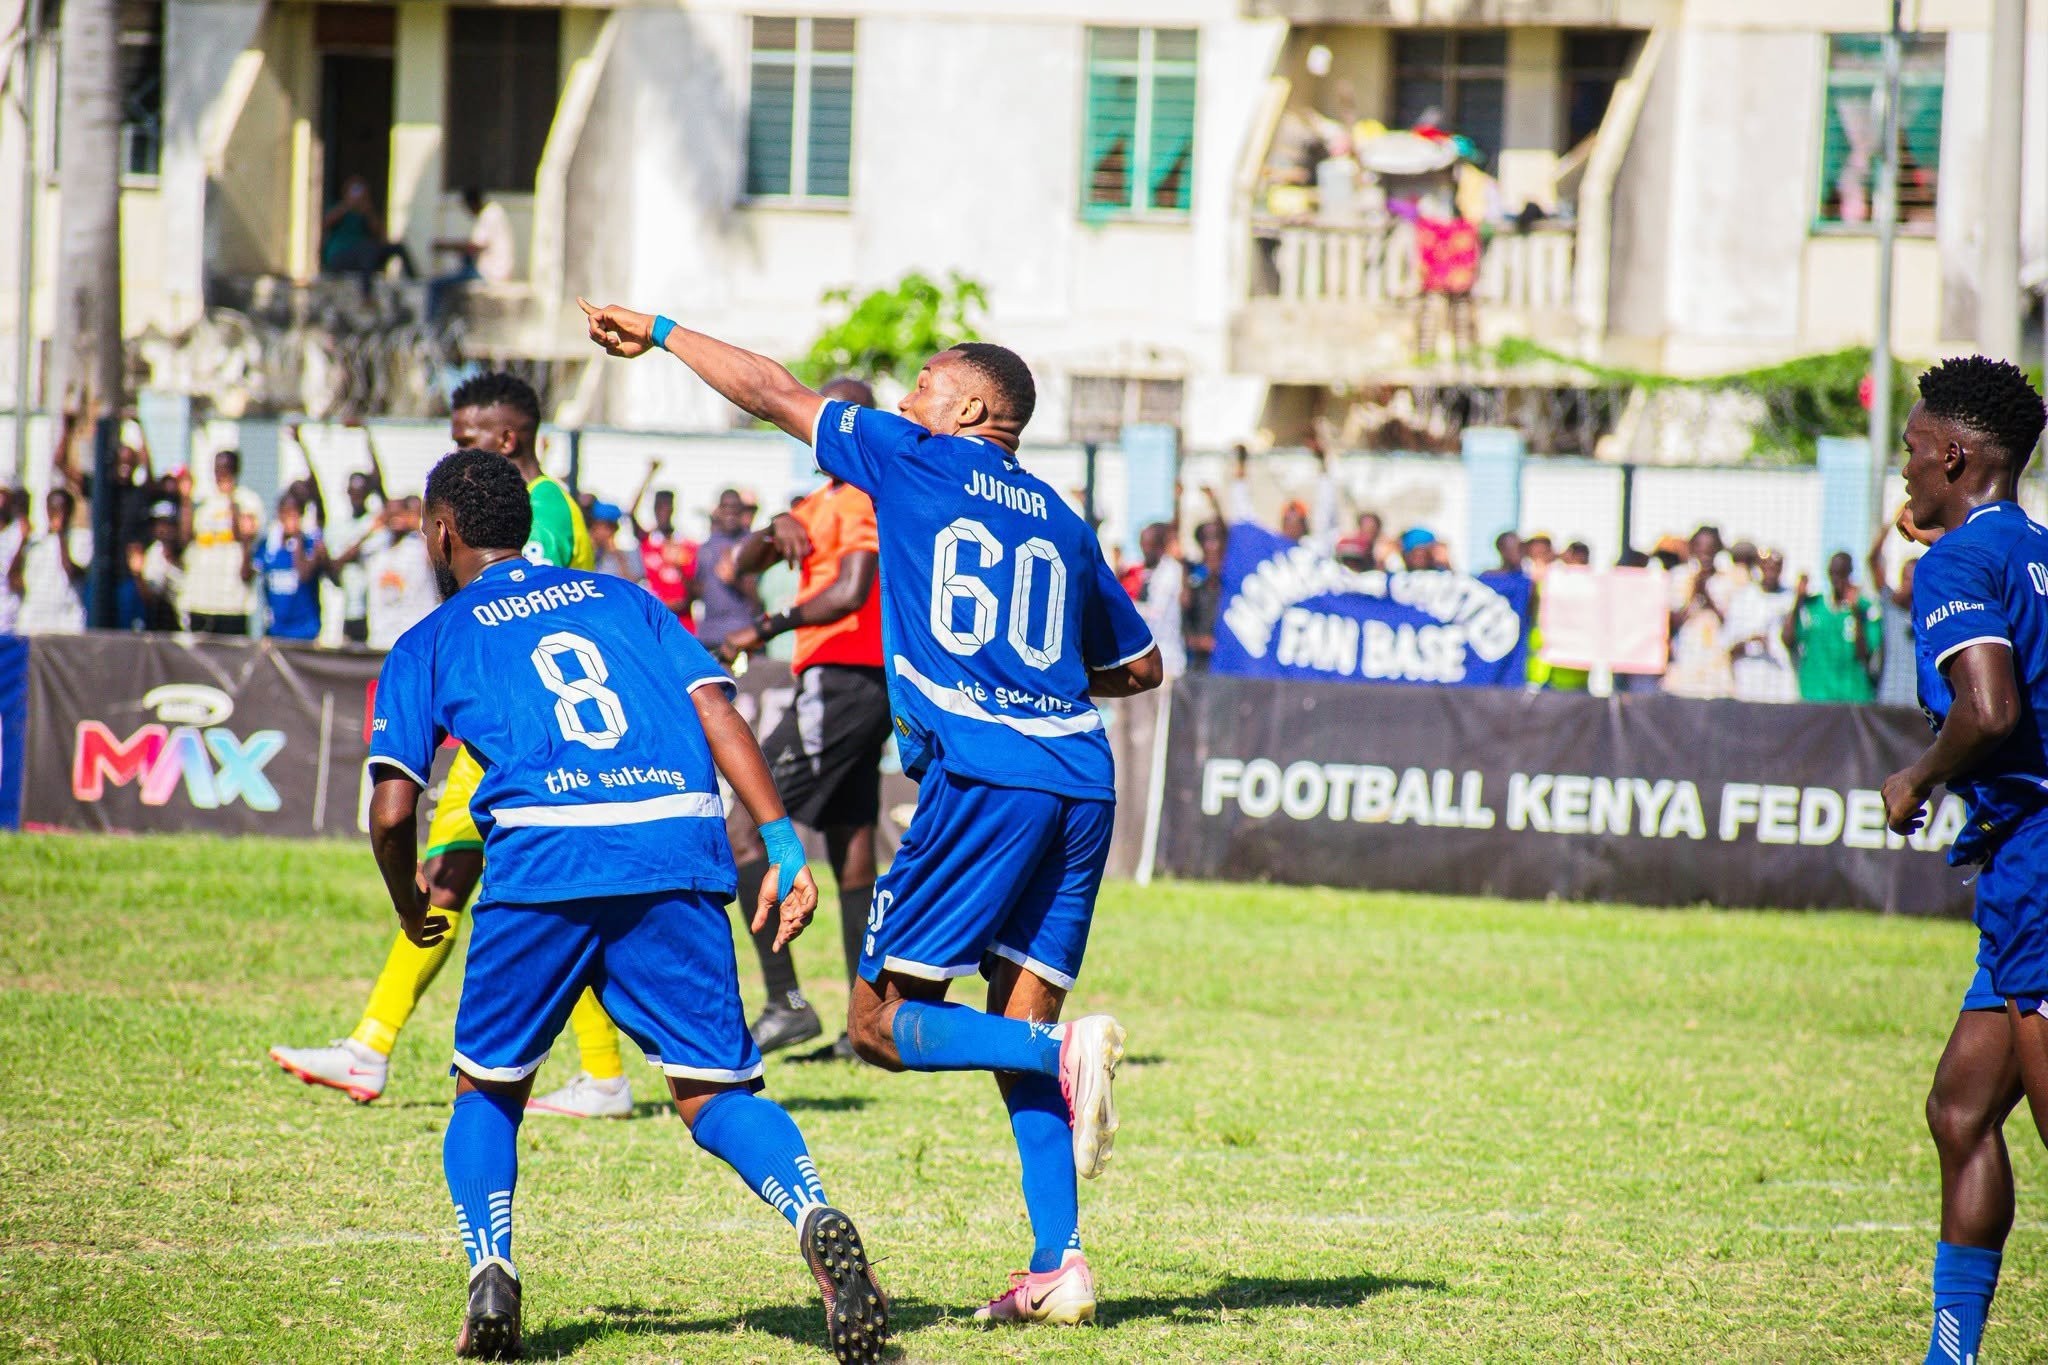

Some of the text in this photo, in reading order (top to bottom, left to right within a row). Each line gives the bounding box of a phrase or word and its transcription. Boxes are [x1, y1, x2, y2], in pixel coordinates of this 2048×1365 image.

[964, 469, 1048, 520] JUNIOR
[472, 580, 605, 626] QUBAAYE
[930, 517, 1067, 671] 60
[1276, 607, 1466, 683] FAN BASE
[530, 631, 628, 750] 8
[72, 720, 286, 812] MAX
[544, 765, 686, 795] the sultans
[1201, 757, 1495, 829] FOOTBALL
[1506, 772, 1706, 840] KENYA
